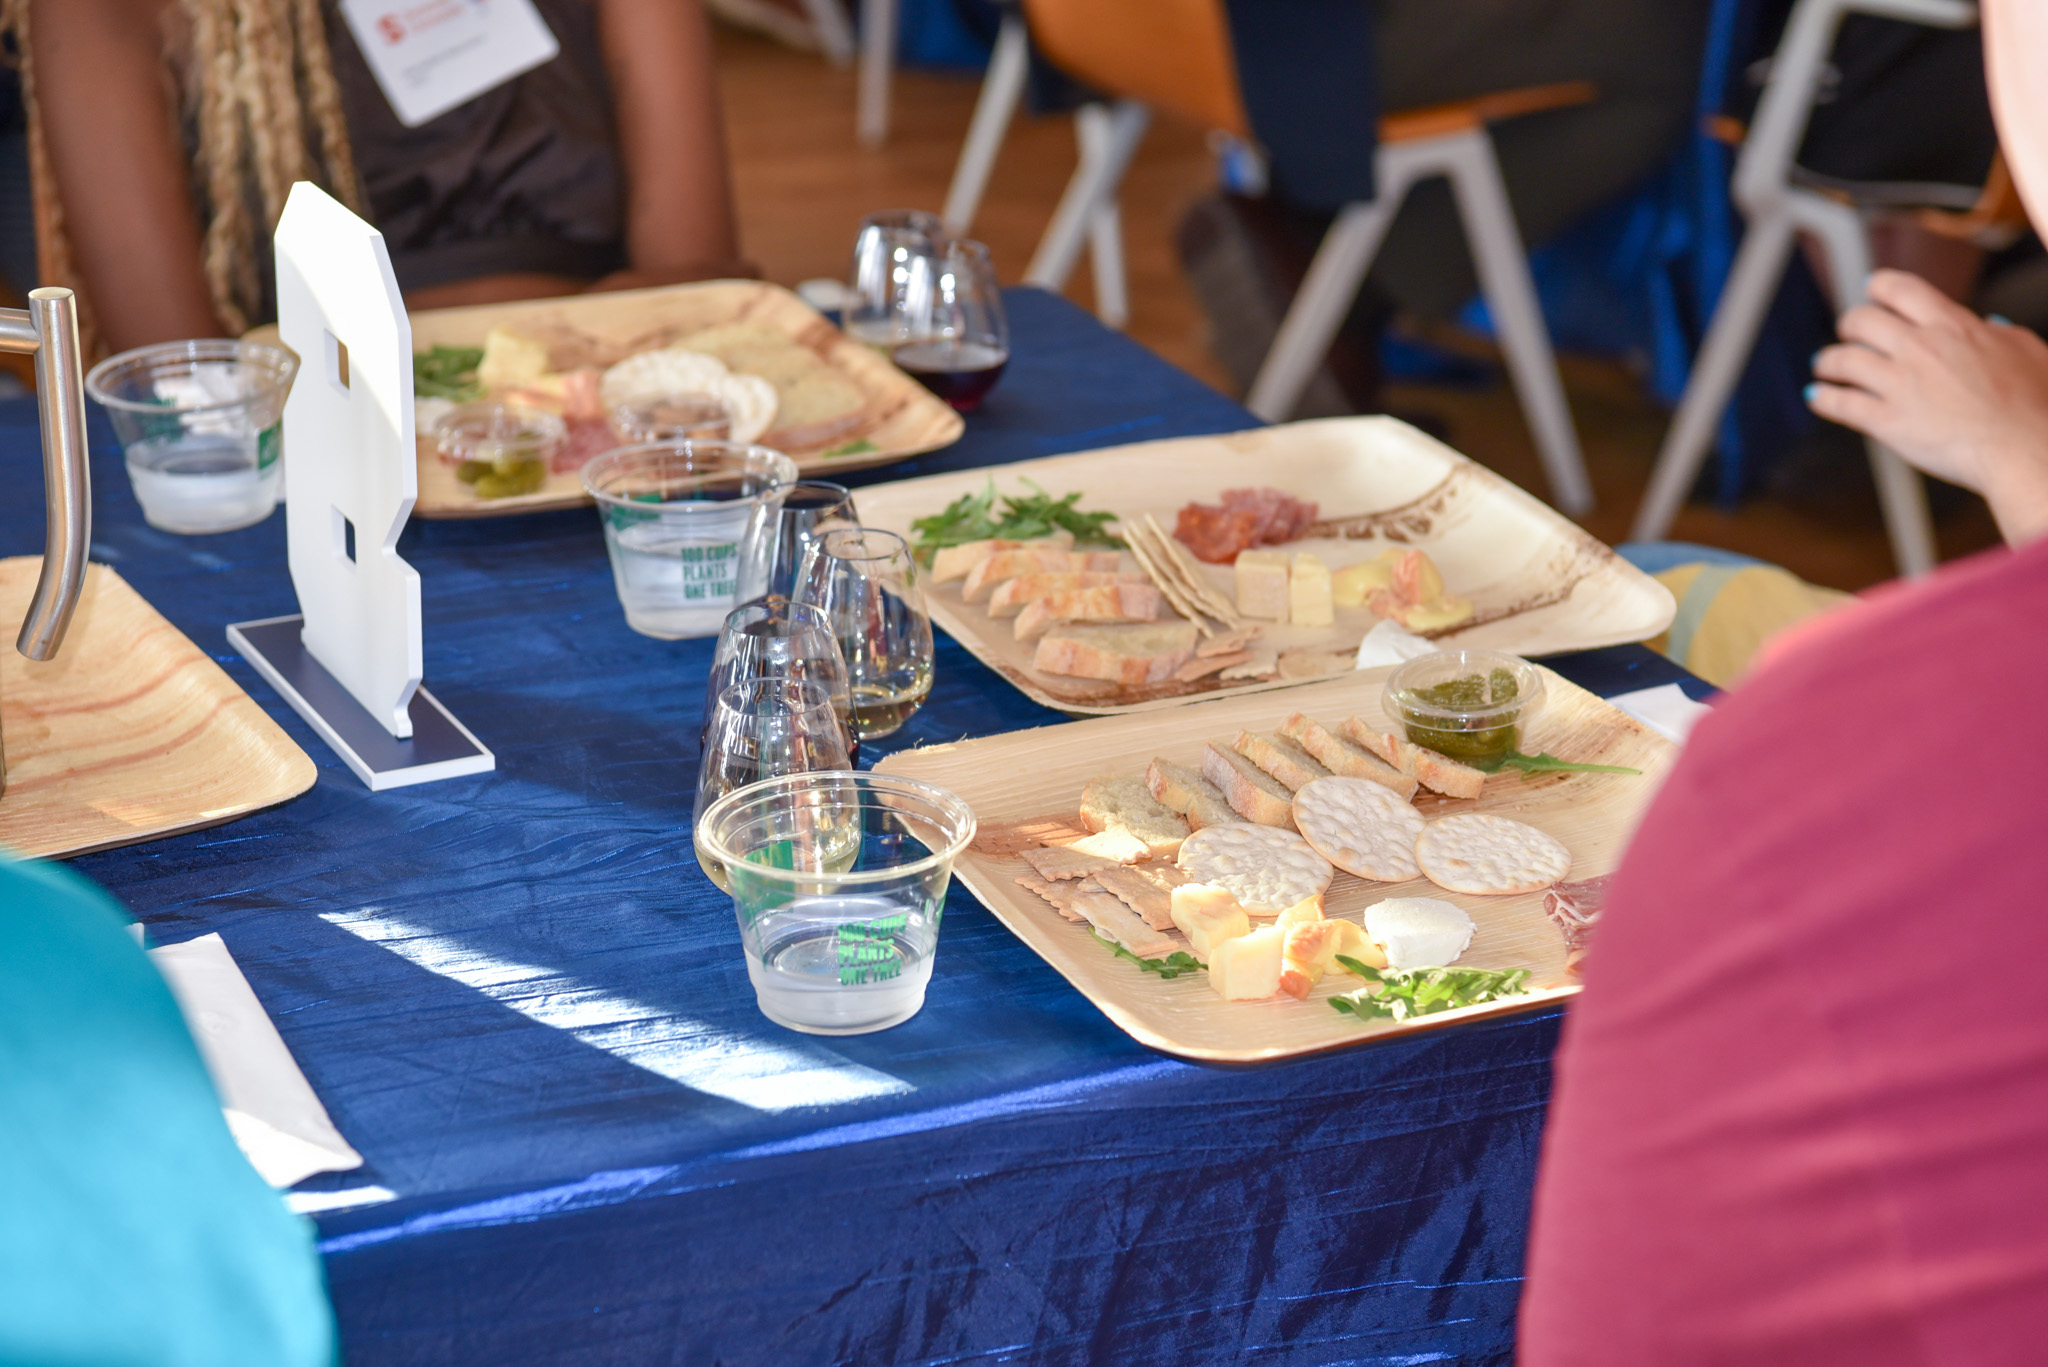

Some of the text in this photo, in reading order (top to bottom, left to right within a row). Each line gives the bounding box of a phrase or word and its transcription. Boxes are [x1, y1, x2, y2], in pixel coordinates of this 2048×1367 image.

[681, 542, 737, 562] 100 CUPS
[683, 563, 727, 580] PLANTS
[685, 583, 706, 599] ONE
[838, 913, 908, 942] 100 CUPS
[838, 938, 895, 965] PLANTS
[840, 958, 902, 986] ONE TREE
